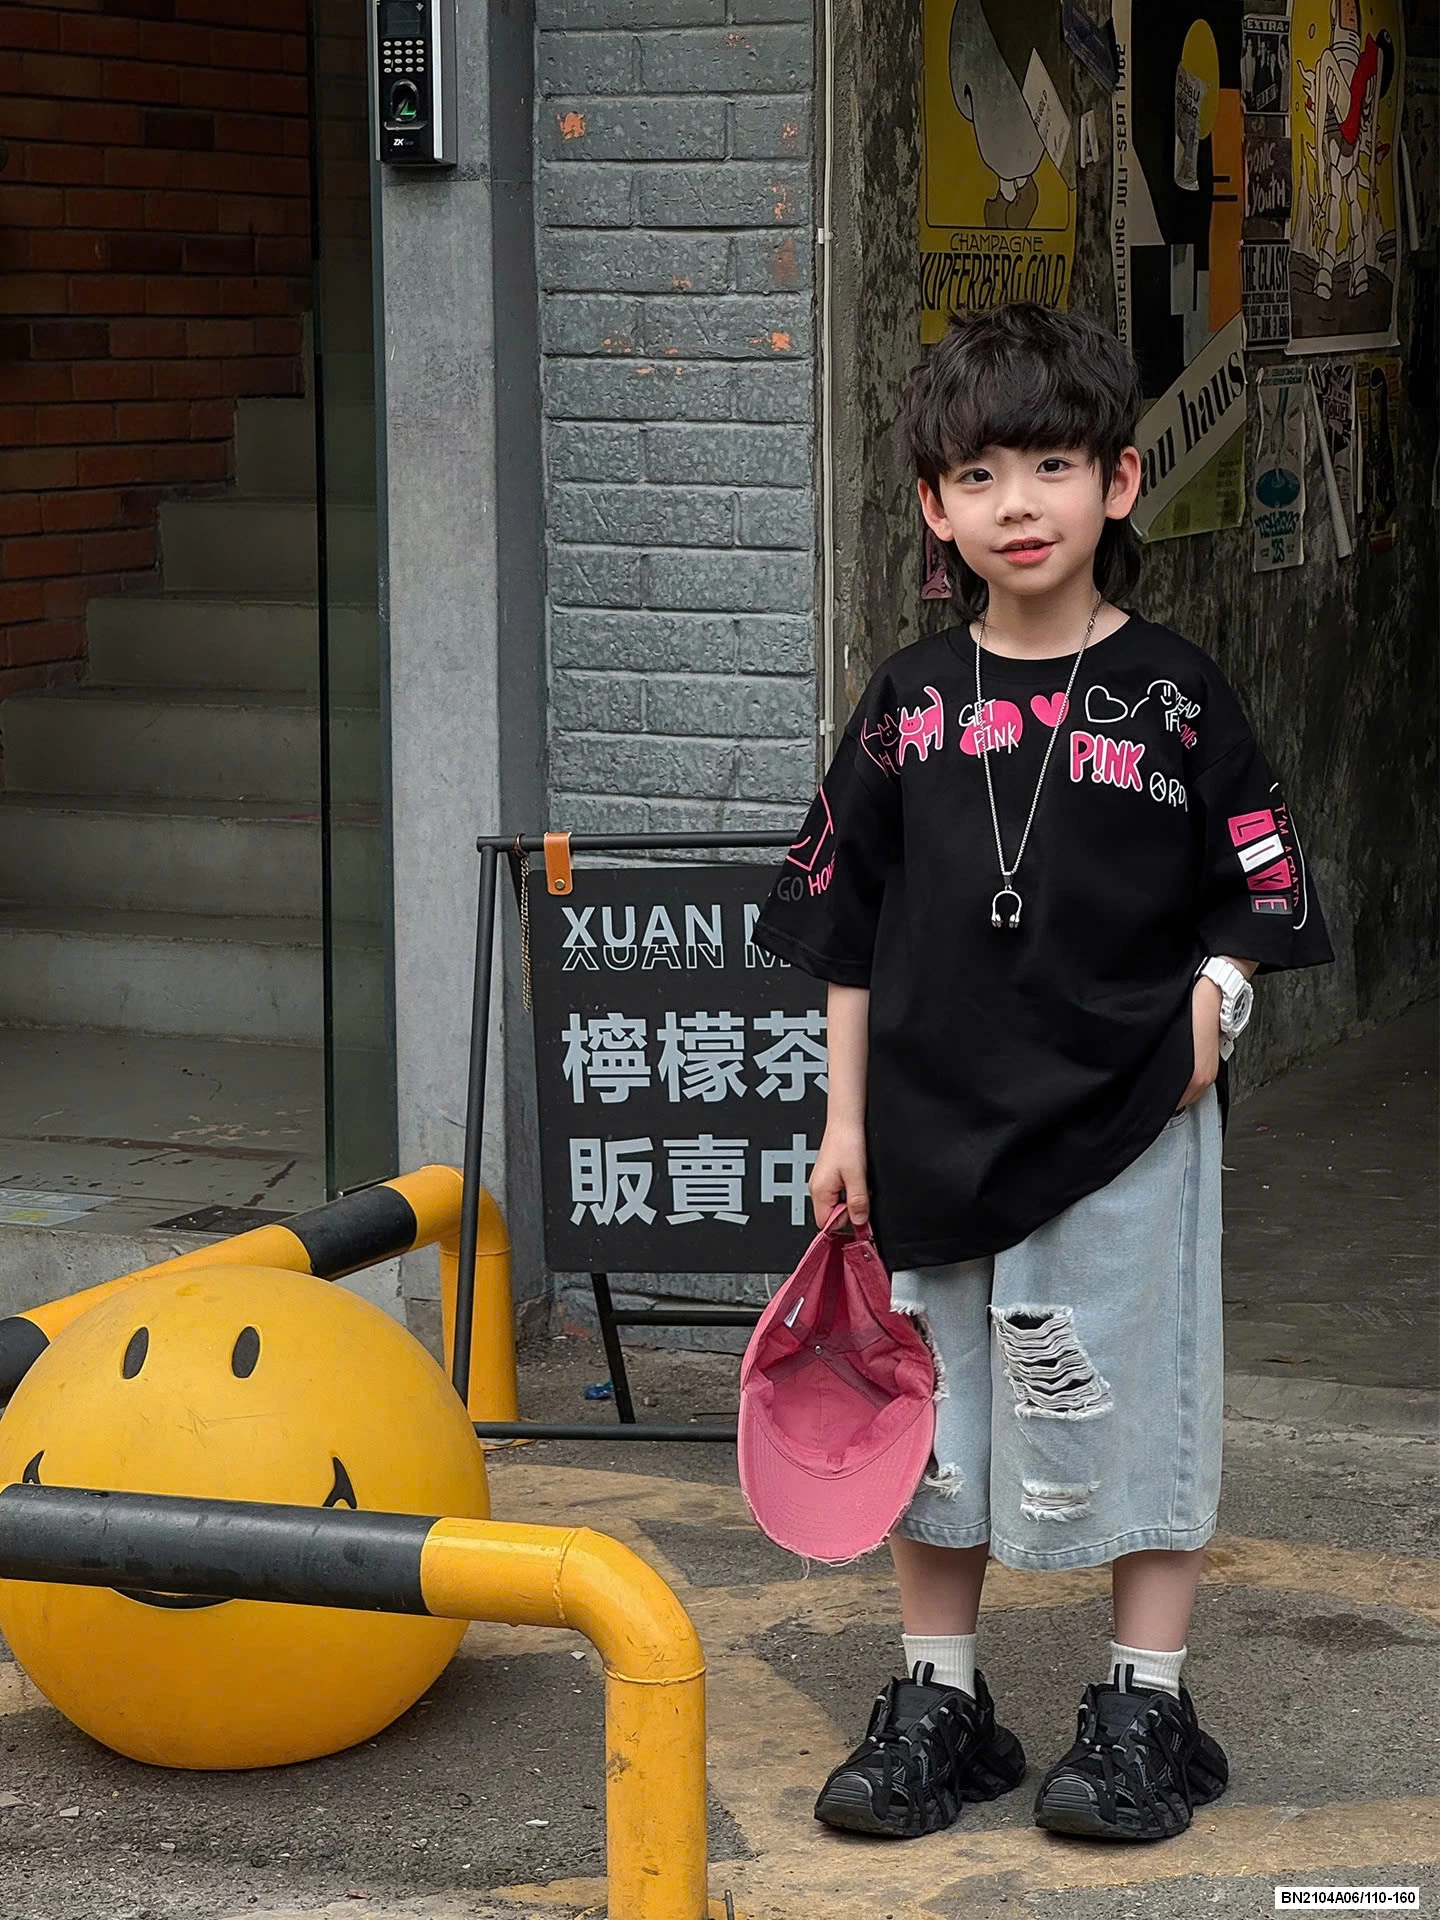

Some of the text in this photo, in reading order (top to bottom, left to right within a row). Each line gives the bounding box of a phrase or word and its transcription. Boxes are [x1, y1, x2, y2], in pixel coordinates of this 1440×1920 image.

[1246, 19, 1285, 31] EXTRA
[950, 233, 1043, 252] CHAMPAGNE
[1024, 254, 1066, 310] GOLD
[1258, 246, 1289, 292] CLASH
[1177, 352, 1244, 455] haus
[958, 699, 996, 727] GET
[1069, 730, 1146, 792] P!NK
[776, 876, 805, 903] GO
[561, 905, 723, 948] XUAN
[562, 1010, 829, 1104] 檸檬茶
[569, 1134, 815, 1227] 販賣中
